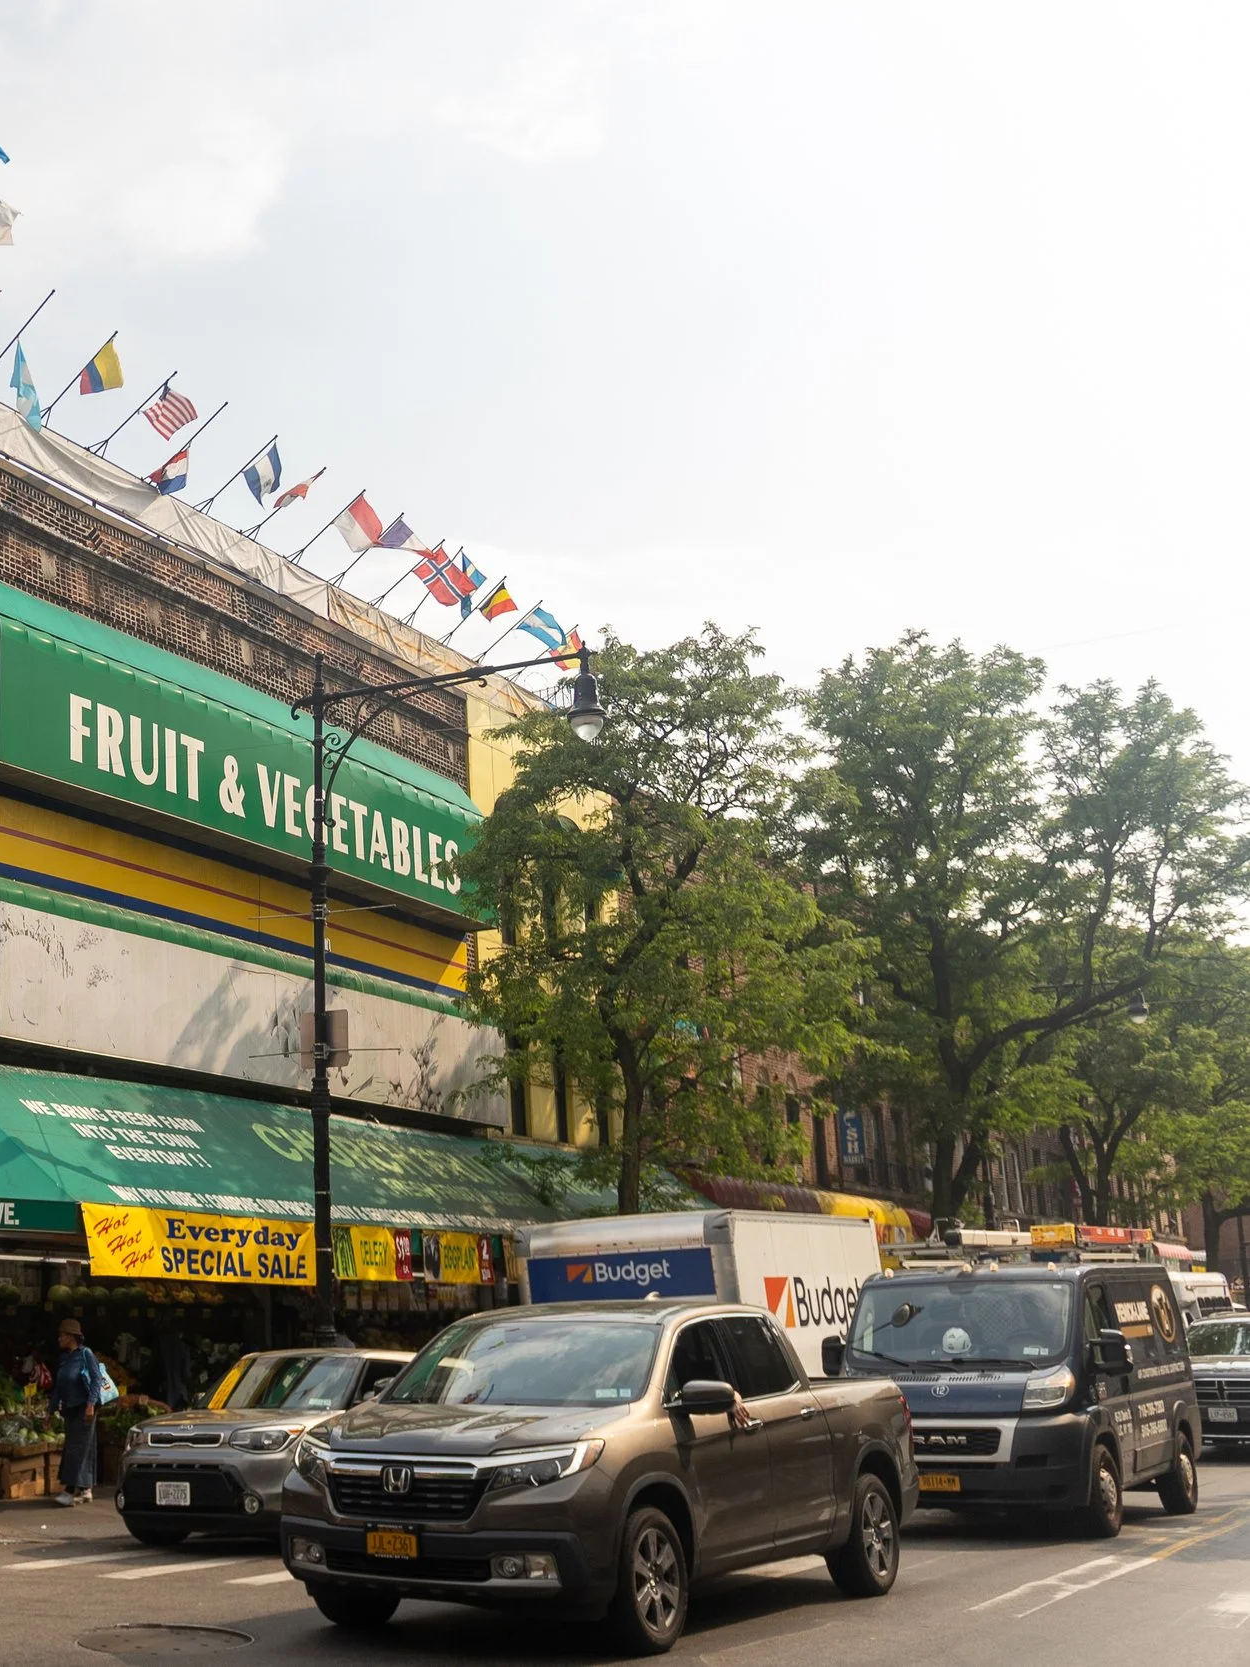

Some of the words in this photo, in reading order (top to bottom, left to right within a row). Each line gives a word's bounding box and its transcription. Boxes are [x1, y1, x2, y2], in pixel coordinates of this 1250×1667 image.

[70, 693, 205, 802] FRUIT
[218, 755, 246, 818] &
[18, 1098, 56, 1117] WE
[50, 1102, 110, 1122] BRING
[104, 1109, 163, 1129] FRESH
[157, 1115, 206, 1134] FARM
[70, 1122, 116, 1141] INTO
[112, 1127, 154, 1146] THE
[147, 1131, 201, 1150] TOWN
[104, 1144, 193, 1168] EVERYDAY
[108, 1184, 141, 1202] WHY
[136, 1187, 163, 1204] PAY
[160, 1189, 199, 1207] MORE
[204, 1193, 266, 1214] COMPARE
[257, 1198, 290, 1215] OUR
[93, 1212, 129, 1238] Hot
[165, 1217, 302, 1251] Everyday
[107, 1229, 143, 1256] Hot
[359, 1240, 389, 1267] CELERY
[121, 1245, 154, 1272] Hot
[161, 1246, 252, 1277] SPECIAL
[258, 1252, 308, 1279] SALE
[443, 1244, 477, 1271] EGGPLANT
[594, 1258, 672, 1286] Budget
[912, 1435, 967, 1445] RAM
